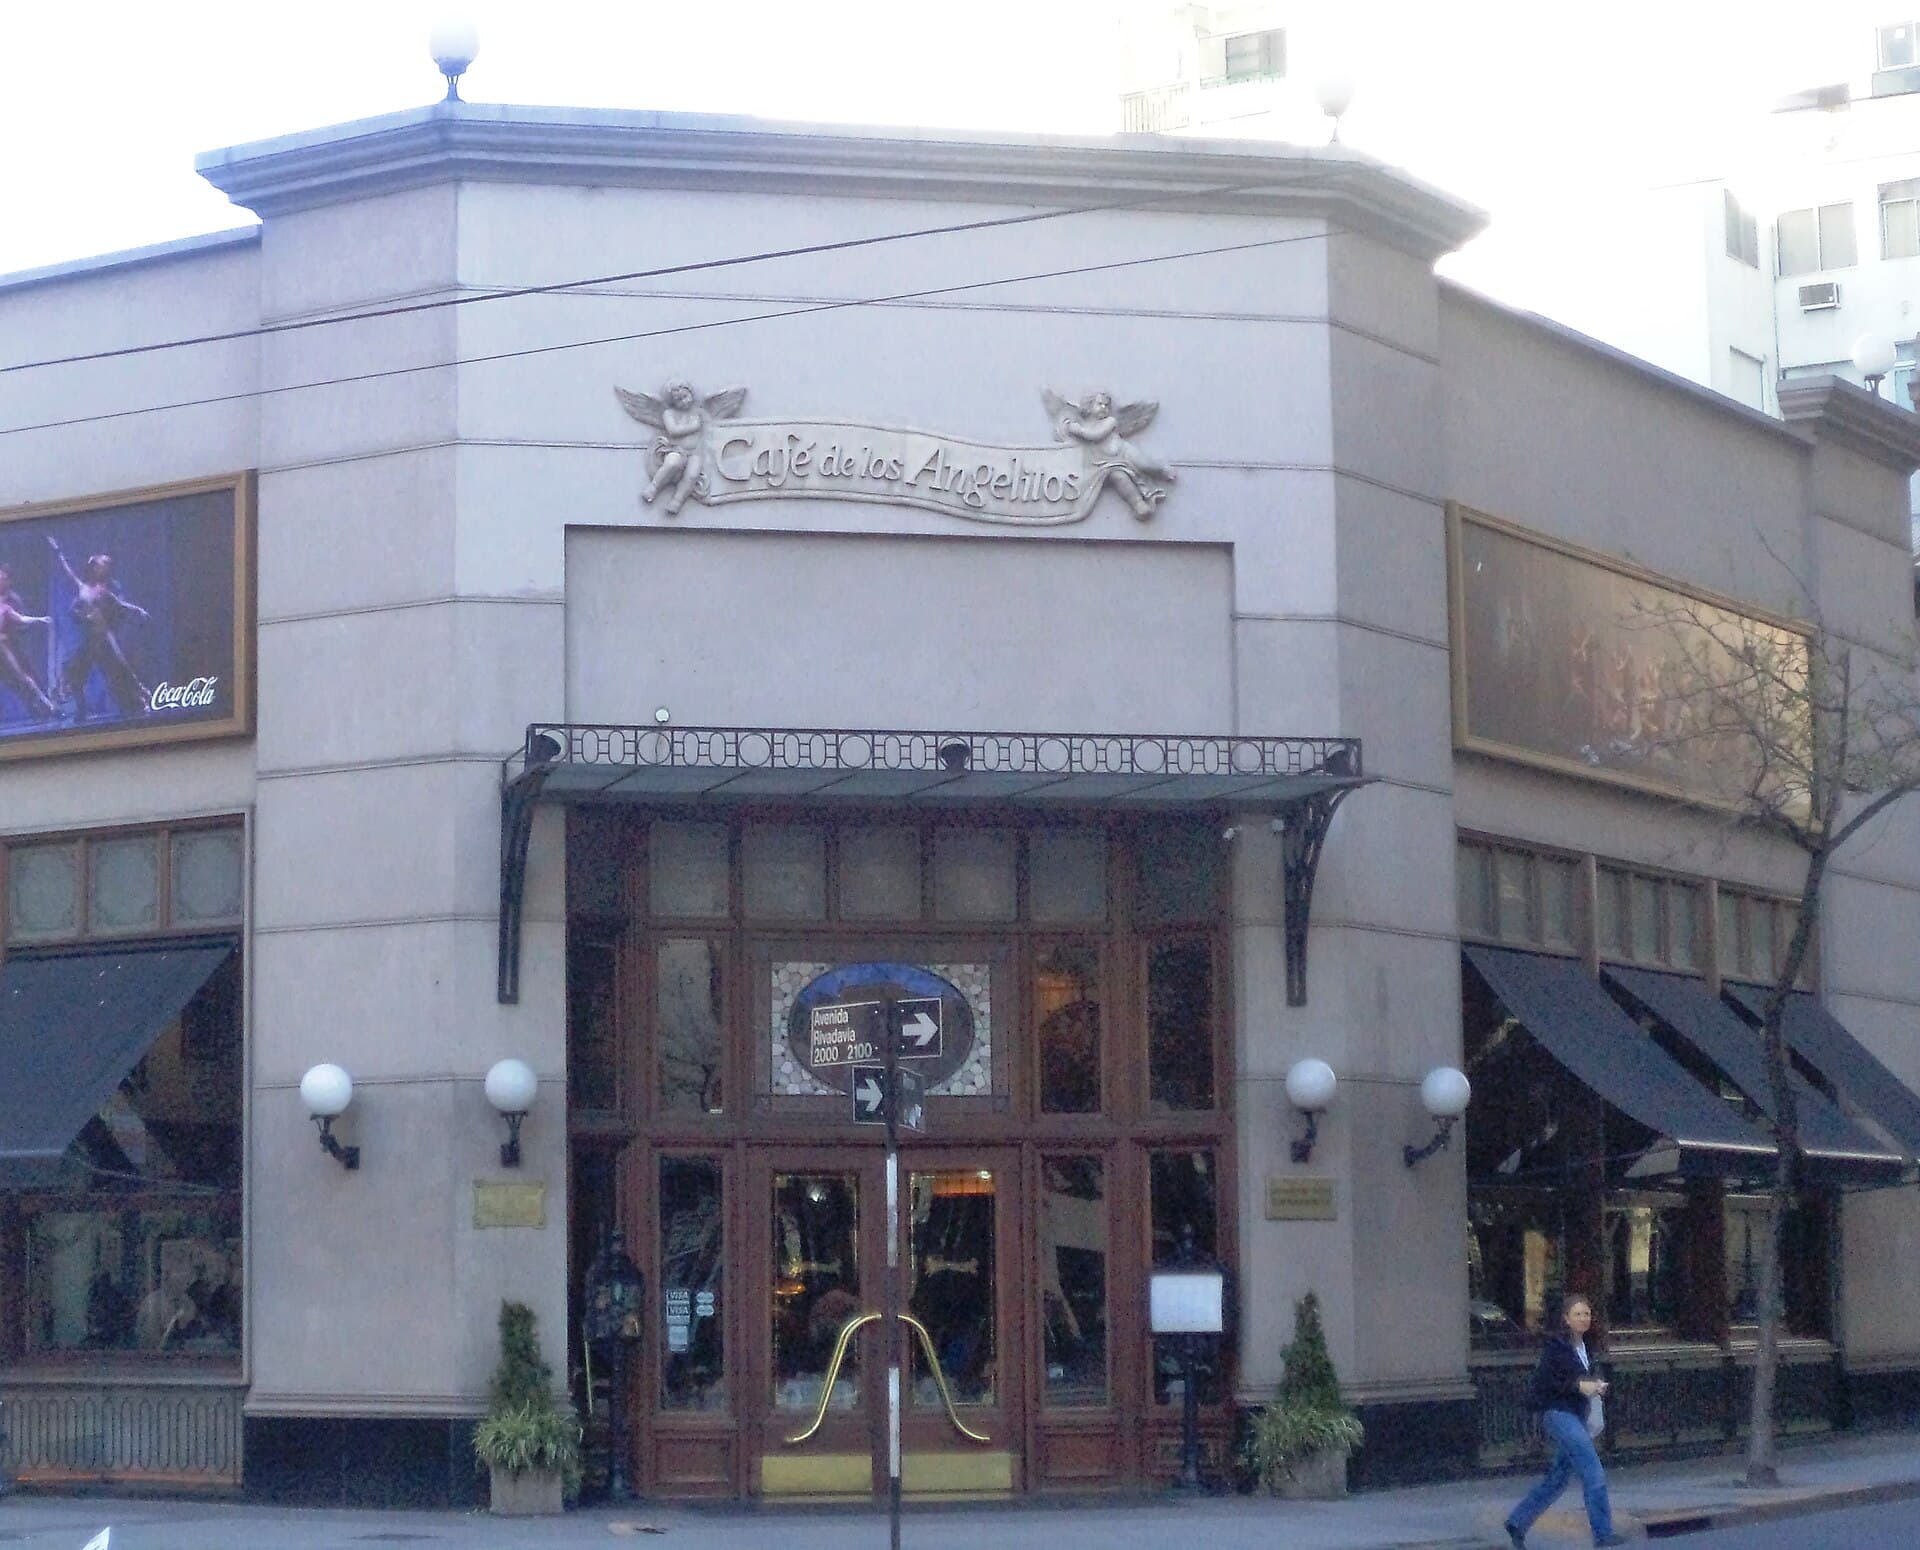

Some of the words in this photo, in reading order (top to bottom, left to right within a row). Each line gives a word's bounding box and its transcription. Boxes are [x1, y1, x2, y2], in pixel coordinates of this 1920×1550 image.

[716, 434, 816, 487] Café
[819, 442, 855, 477] de
[860, 446, 904, 481] los
[905, 449, 1081, 508] Angelitos
[151, 676, 218, 710] Coca-Cola
[814, 1008, 849, 1026] Avenida
[813, 1028, 856, 1046] Rivadavia
[814, 1046, 839, 1063] 2000
[847, 1042, 872, 1060] 2100
